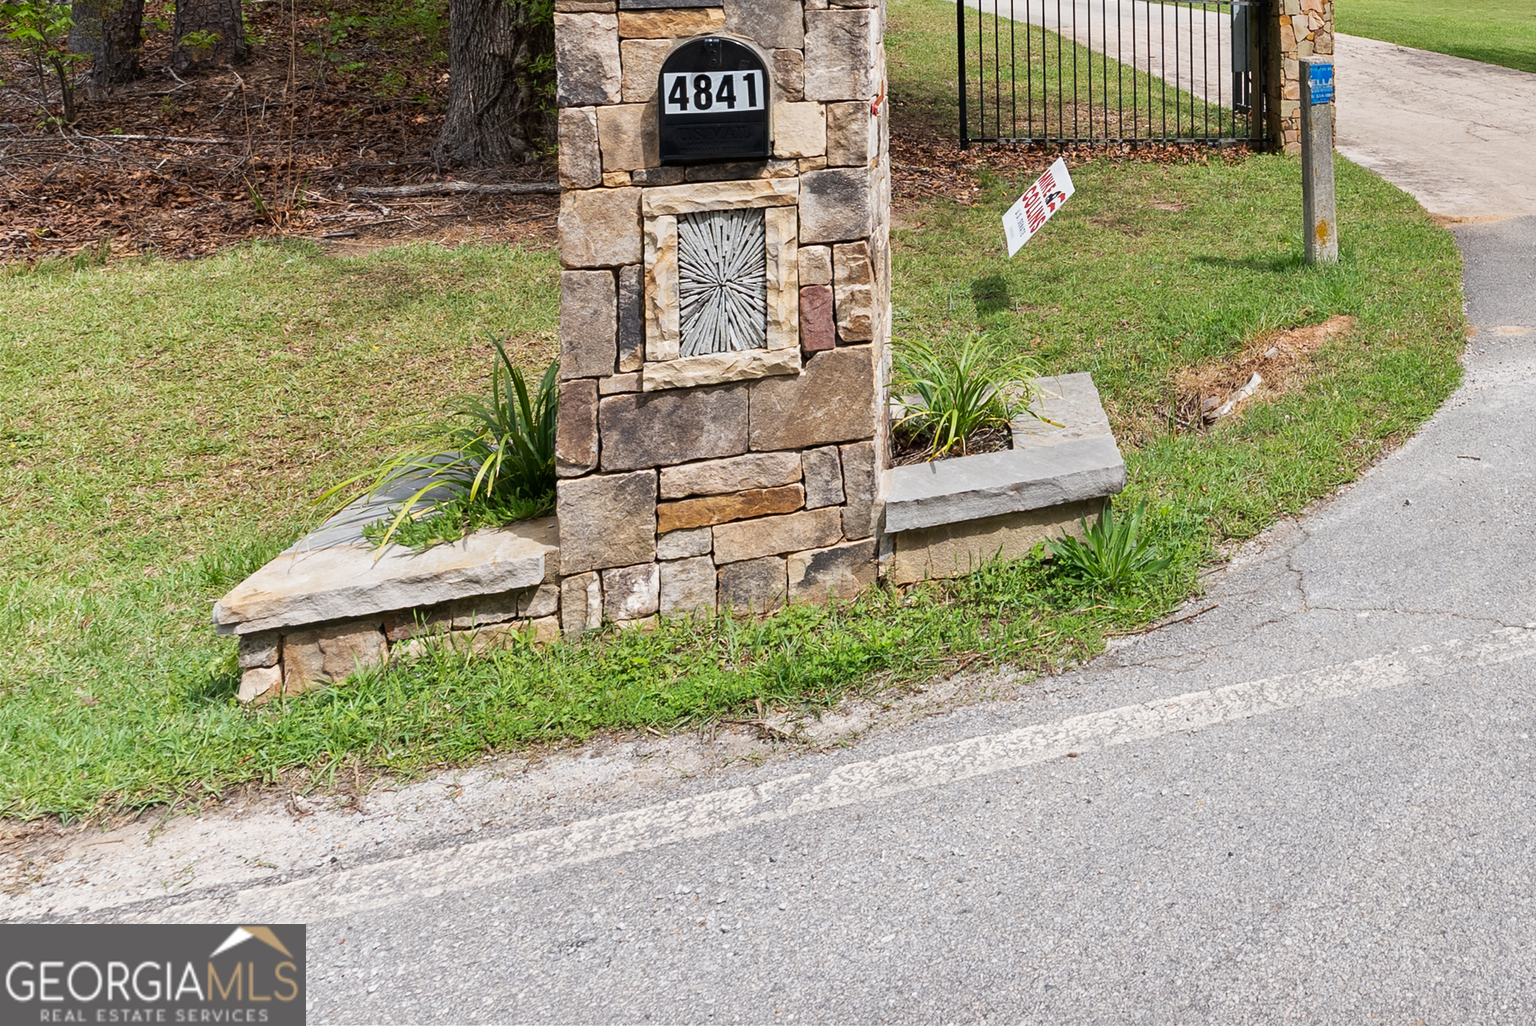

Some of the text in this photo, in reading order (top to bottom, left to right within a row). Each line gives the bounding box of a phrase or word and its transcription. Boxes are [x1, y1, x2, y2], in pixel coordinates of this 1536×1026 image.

[668, 73, 757, 111] 4841
[1038, 169, 1056, 198] MIKE
[1022, 185, 1046, 233] COLLINS
